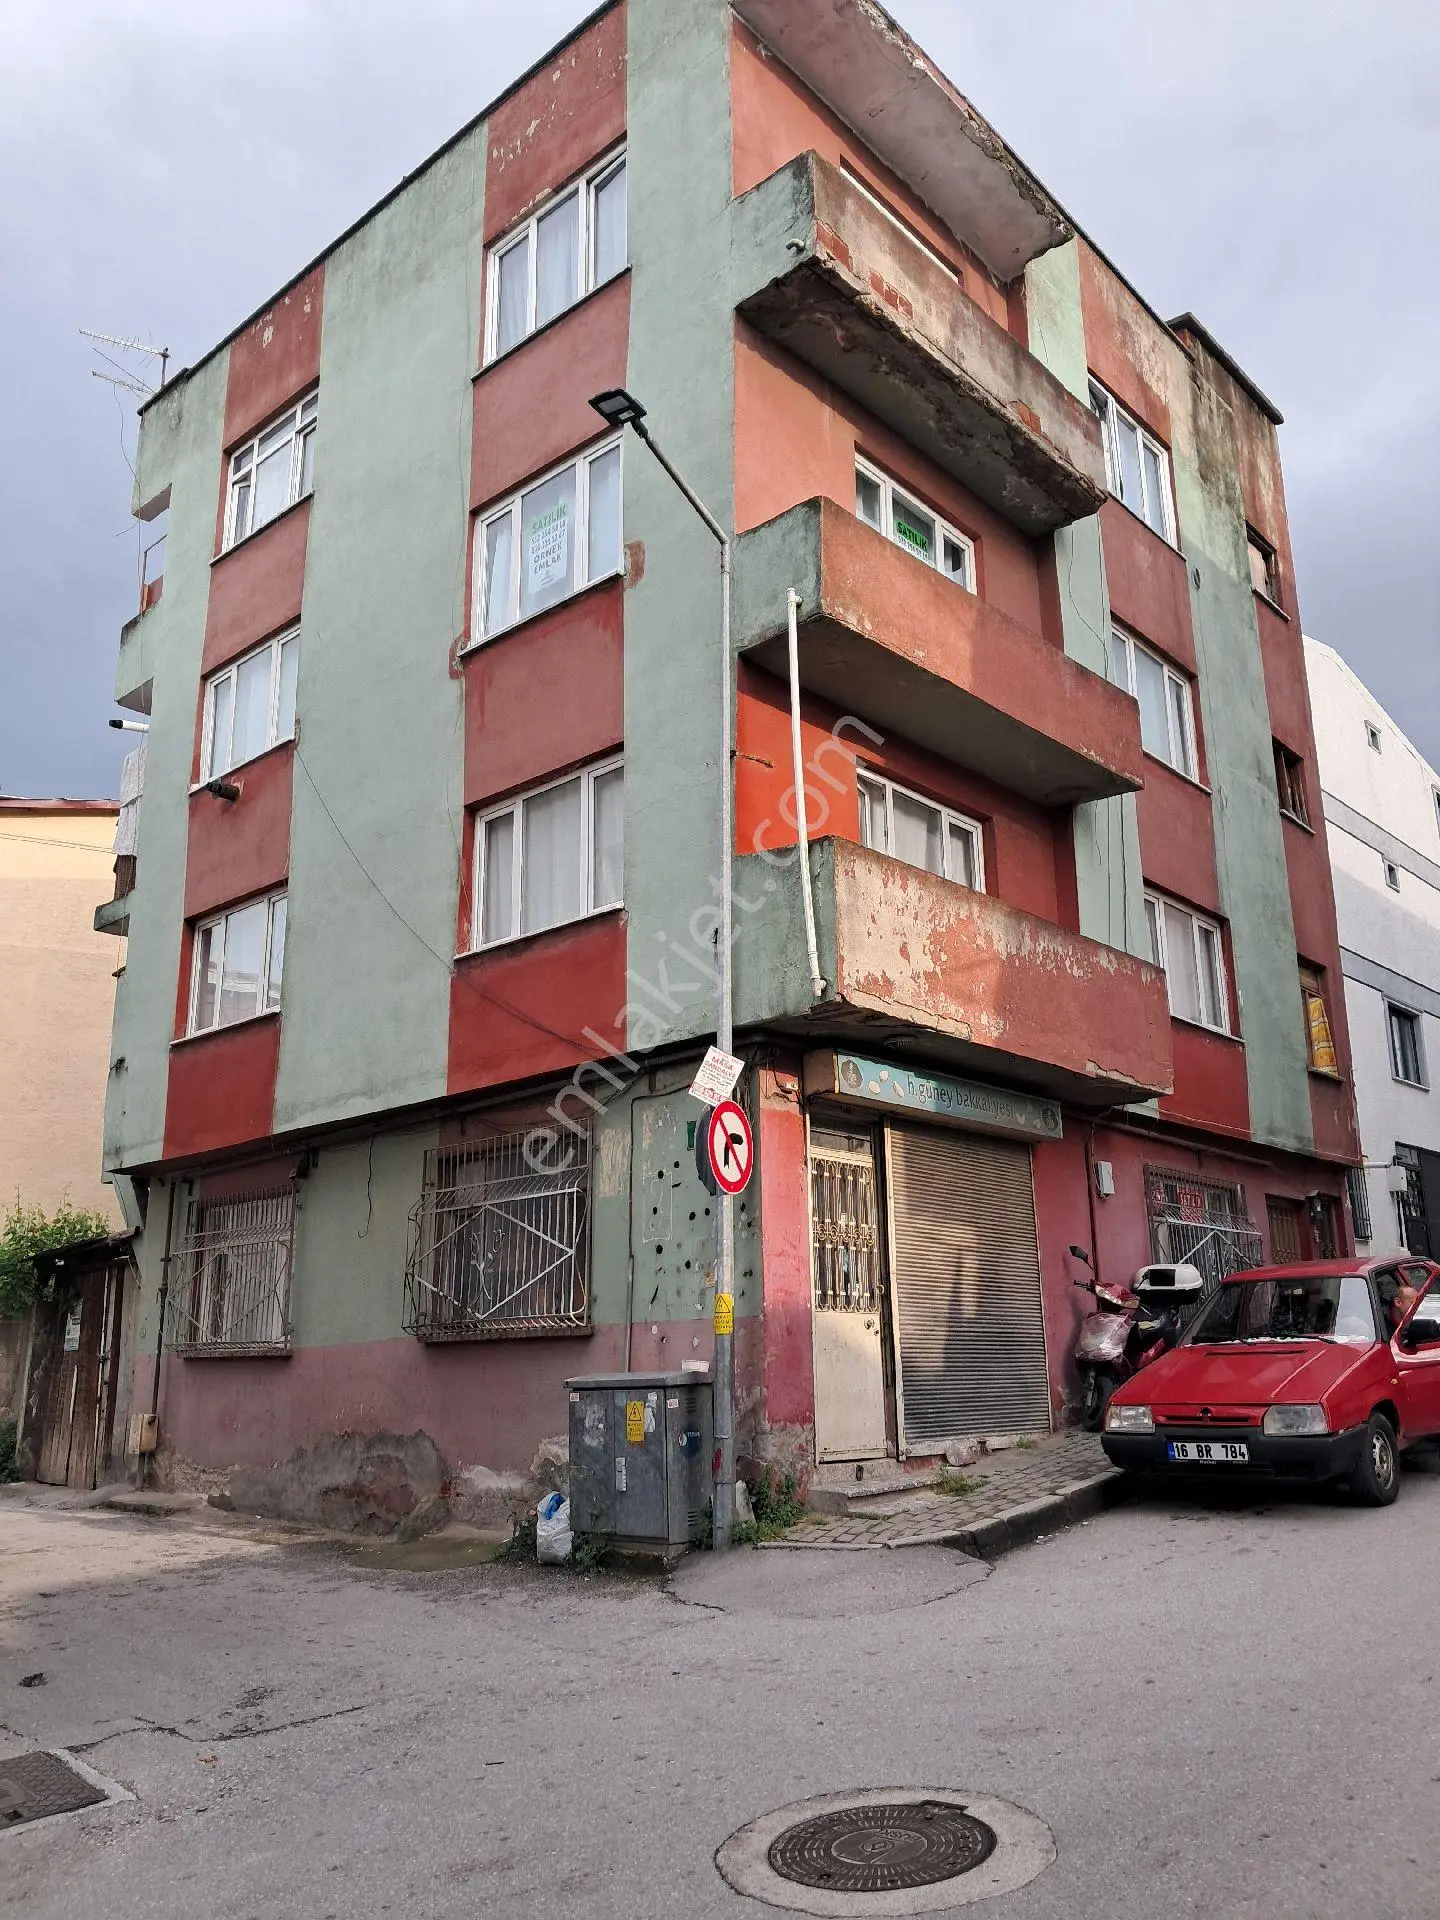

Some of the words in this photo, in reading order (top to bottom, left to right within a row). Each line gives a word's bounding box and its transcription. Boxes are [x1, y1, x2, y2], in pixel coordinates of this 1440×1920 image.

[532, 504, 566, 534] SATILIK
[897, 522, 928, 552] SATILIK
[533, 552, 562, 575] EMLAK
[711, 1056, 733, 1071] MASA
[955, 1087, 1015, 1122] bakkaliyesi
[1175, 1443, 1188, 1458] 16
[1196, 1444, 1213, 1459] BR
[1221, 1444, 1246, 1460] 784
